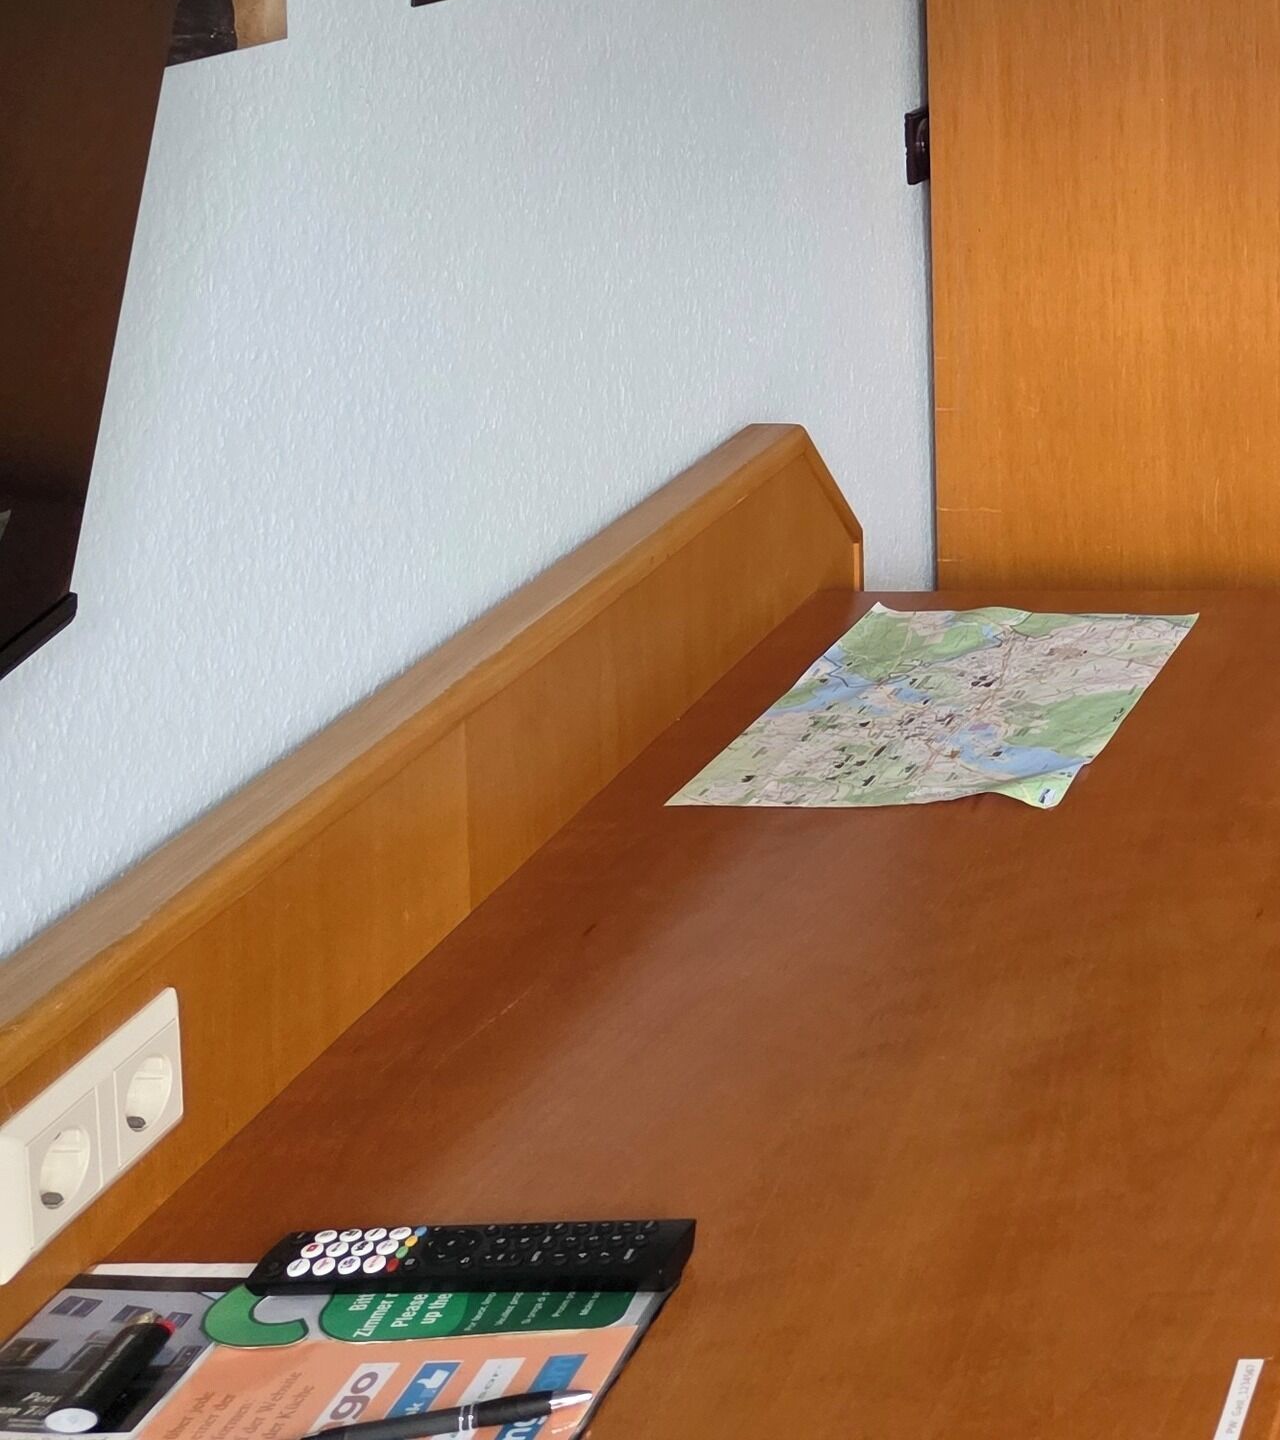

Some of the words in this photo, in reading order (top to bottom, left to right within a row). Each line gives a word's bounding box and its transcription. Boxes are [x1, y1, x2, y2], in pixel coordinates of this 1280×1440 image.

[390, 1293, 430, 1328] Please
[420, 1308, 439, 1325] up
[428, 1292, 453, 1313] the
[353, 1300, 393, 1338] Zimmer
